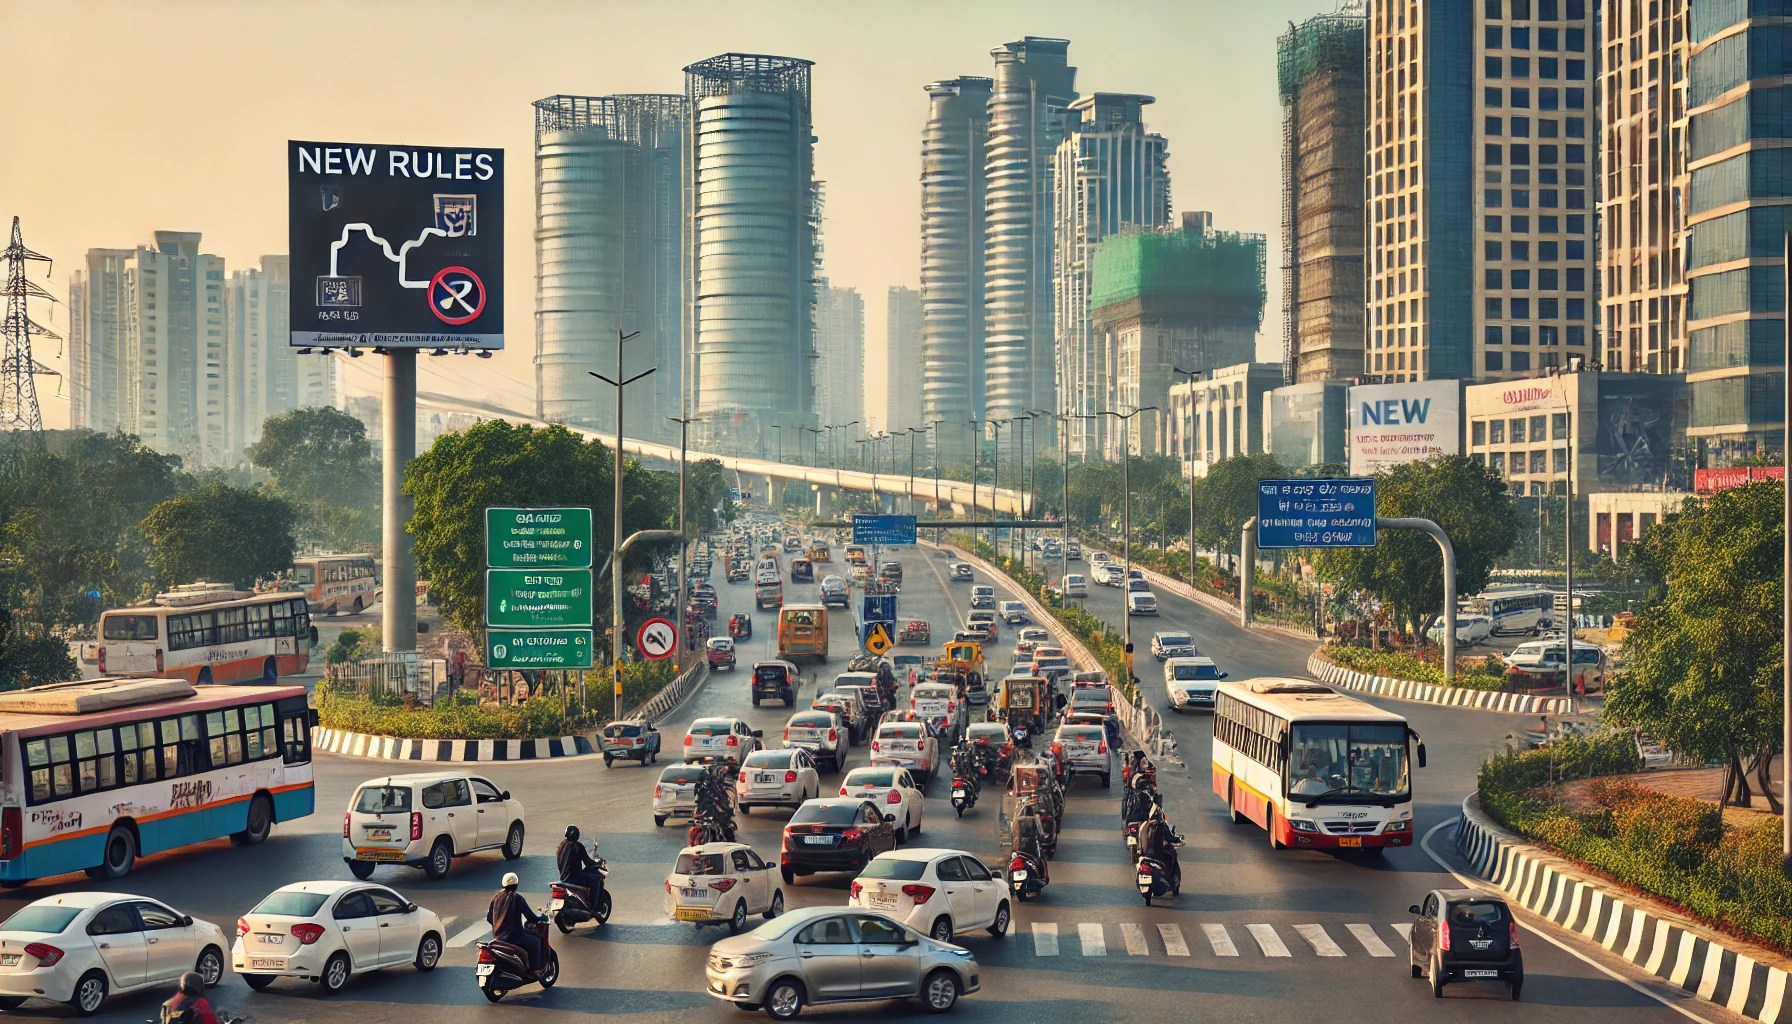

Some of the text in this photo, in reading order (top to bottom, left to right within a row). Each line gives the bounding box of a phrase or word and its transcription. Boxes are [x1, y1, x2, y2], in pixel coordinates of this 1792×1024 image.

[298, 147, 494, 181] NEW RULES
[1361, 397, 1431, 426] NEW
